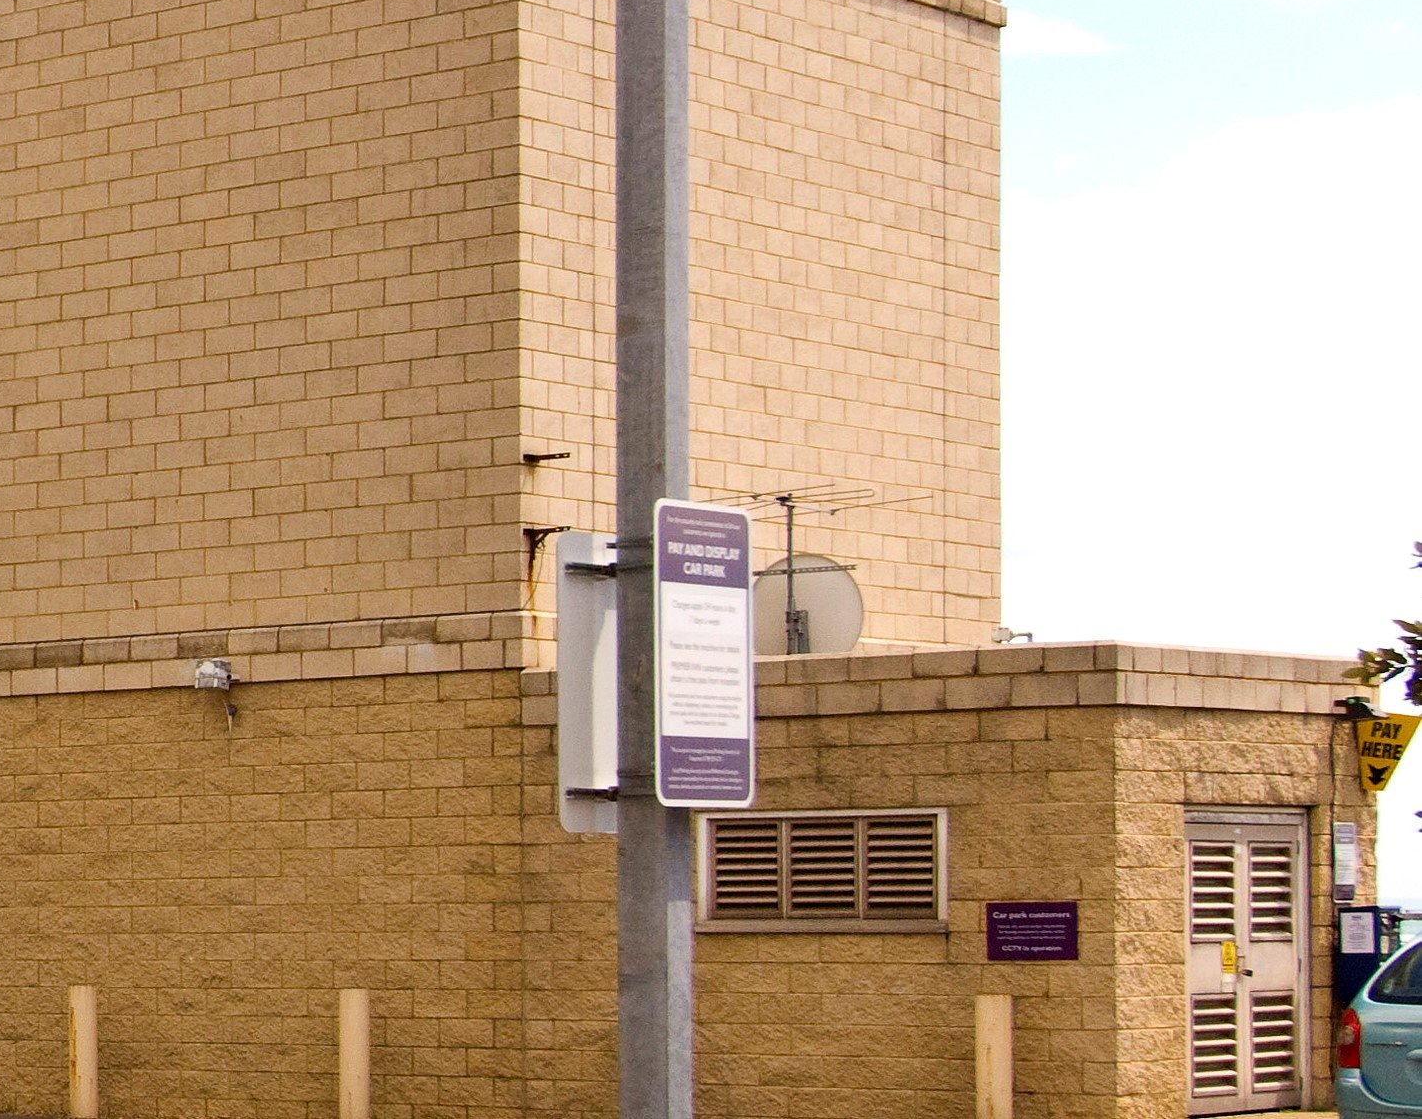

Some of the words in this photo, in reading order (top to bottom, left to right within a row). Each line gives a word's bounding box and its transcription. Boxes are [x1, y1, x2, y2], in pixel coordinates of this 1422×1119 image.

[667, 541, 684, 555] PAY
[684, 543, 705, 558] AND
[705, 545, 741, 561] DISPLAY
[683, 561, 703, 576] CAR
[702, 563, 726, 578] PARK
[1371, 722, 1403, 740] PAY
[1361, 741, 1404, 761] HERE
[992, 911, 1008, 919] Car
[1008, 911, 1027, 920] park
